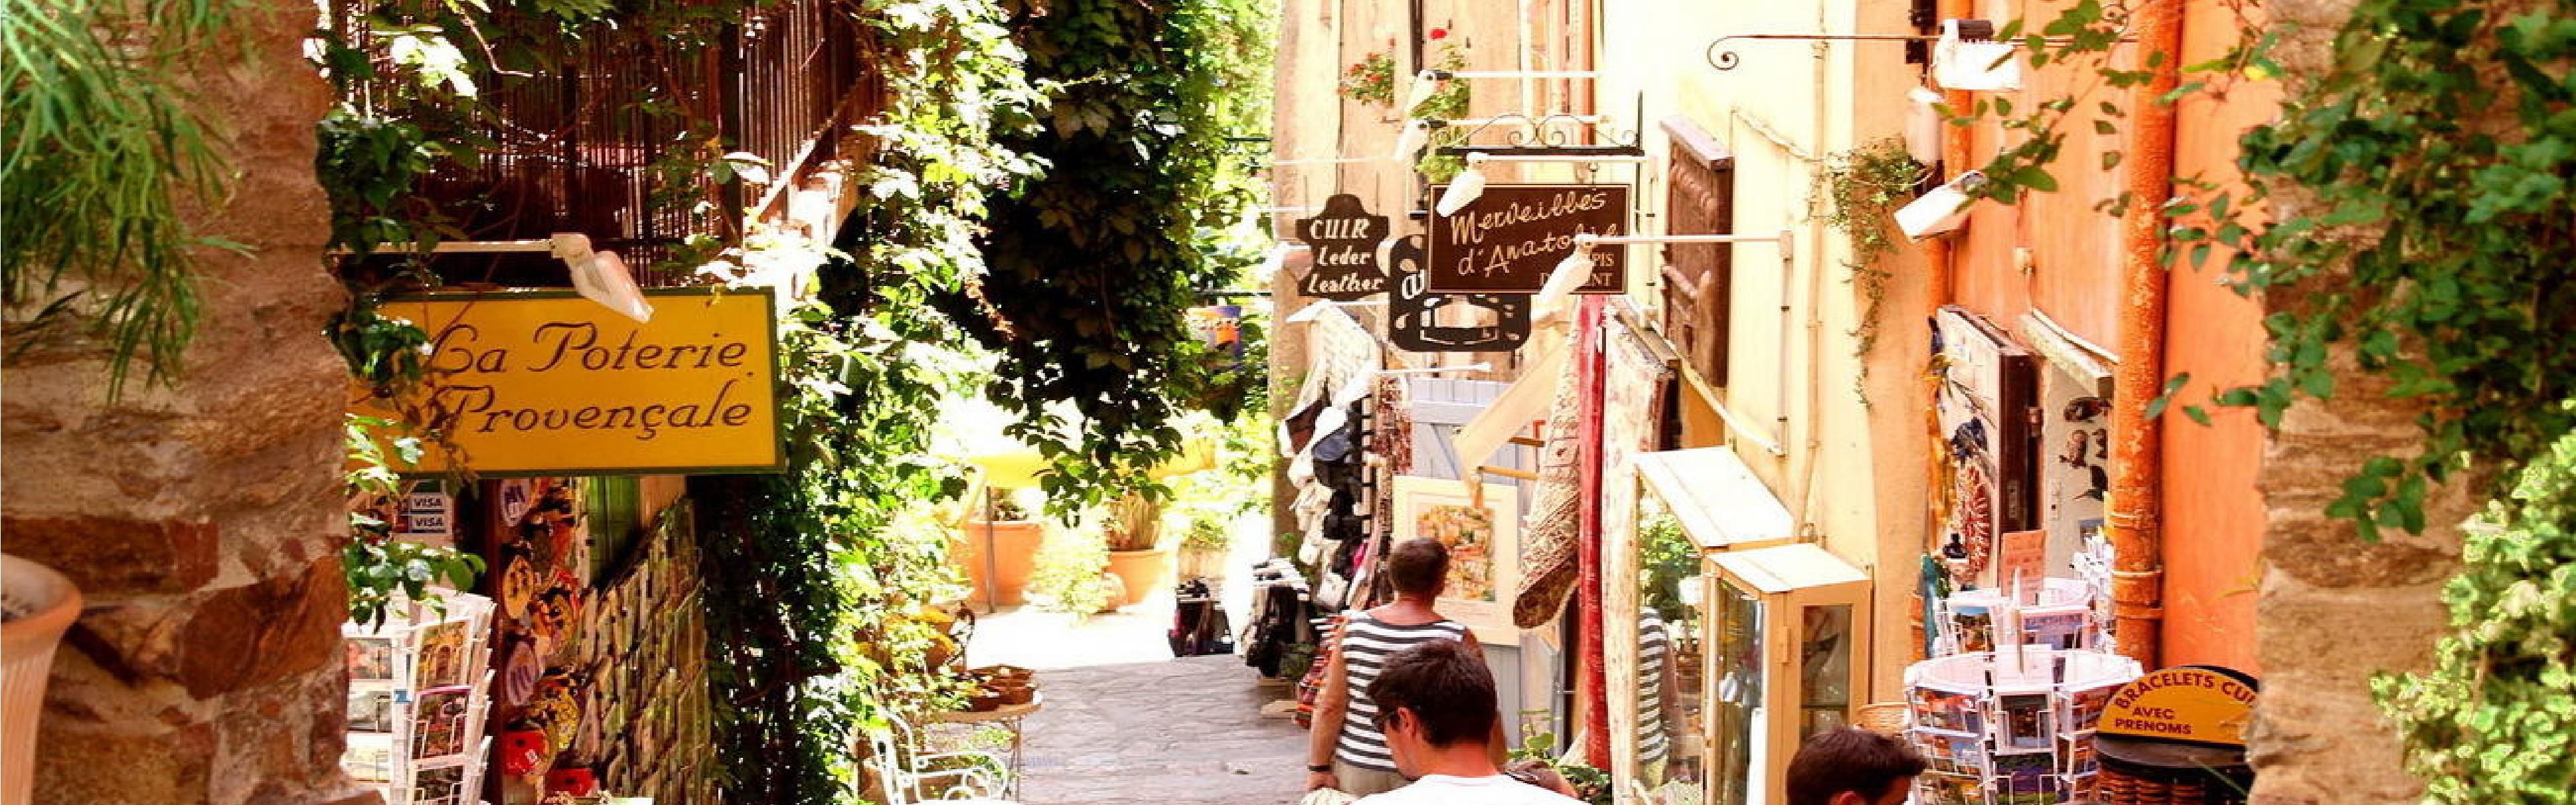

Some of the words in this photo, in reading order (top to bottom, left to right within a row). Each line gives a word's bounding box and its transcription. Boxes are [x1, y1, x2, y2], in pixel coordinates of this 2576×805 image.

[1309, 218, 1370, 240] CUIR
[1317, 245, 1372, 266] Leder
[1307, 272, 1384, 293] Leather
[425, 324, 507, 373] La
[526, 322, 748, 373] Poterie
[429, 378, 752, 439] Provençale
[414, 498, 443, 508] VISA
[415, 517, 444, 527] VISA
[2115, 672, 2215, 710] BRACELETS
[2132, 706, 2176, 720] AVEC
[2115, 717, 2192, 735] PRENOMS
